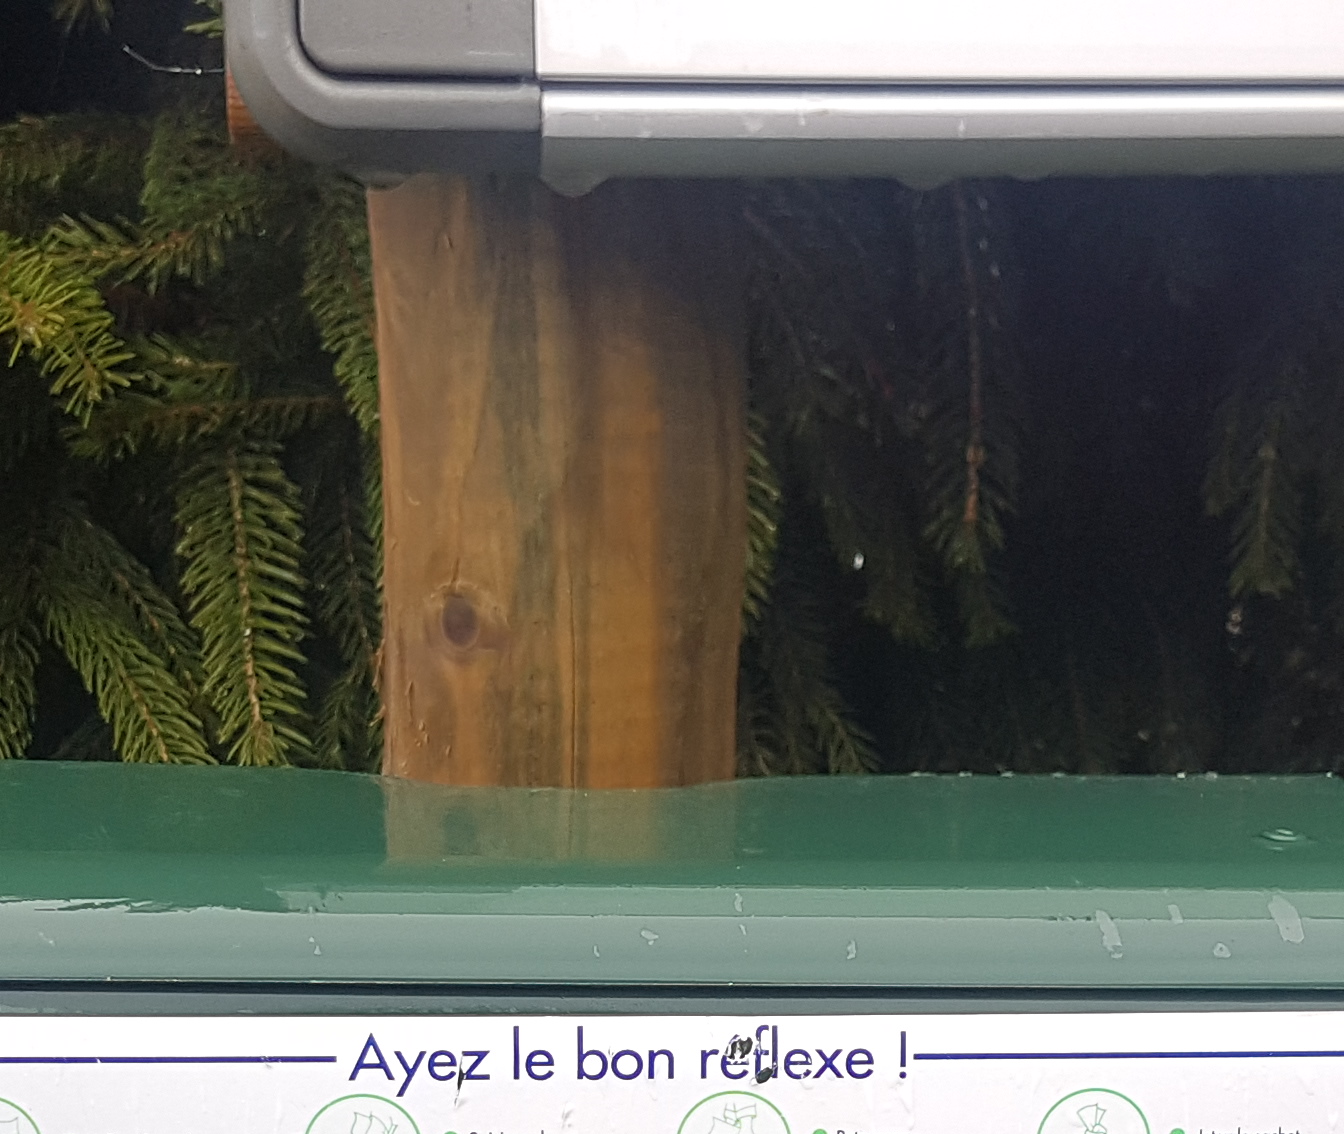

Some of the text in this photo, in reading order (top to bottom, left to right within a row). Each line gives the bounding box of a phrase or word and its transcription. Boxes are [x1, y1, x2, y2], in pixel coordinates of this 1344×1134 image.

[348, 1032, 491, 1097] Ayez
[512, 1025, 556, 1082] le
[576, 1025, 675, 1081] bon
[898, 1030, 908, 1080] !
